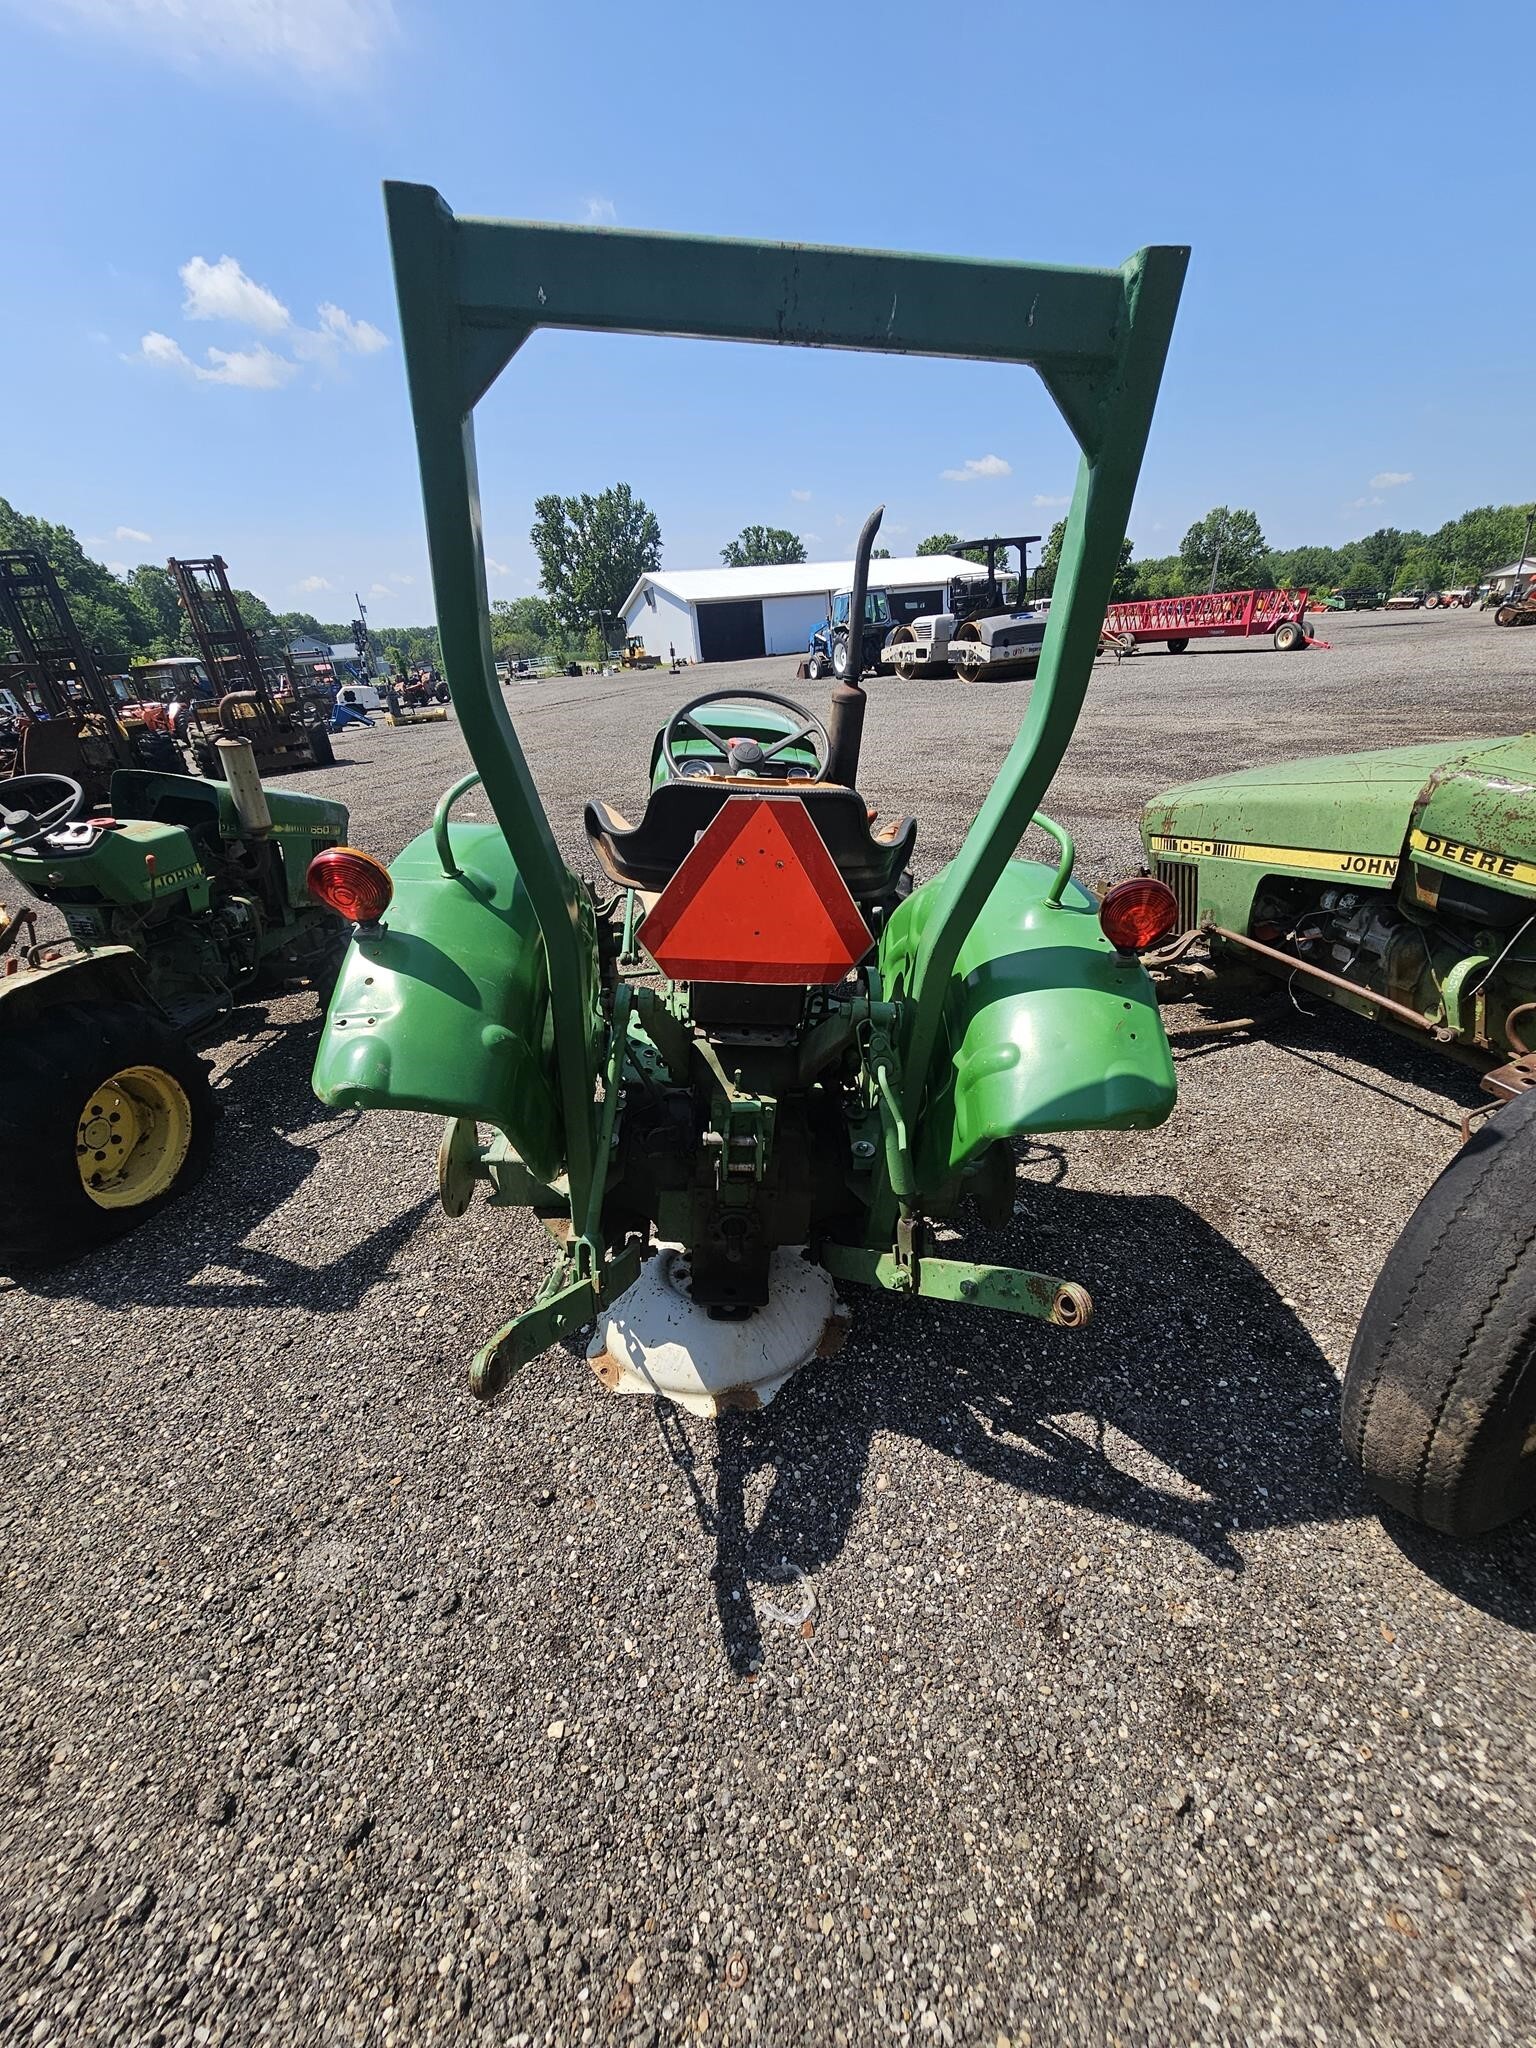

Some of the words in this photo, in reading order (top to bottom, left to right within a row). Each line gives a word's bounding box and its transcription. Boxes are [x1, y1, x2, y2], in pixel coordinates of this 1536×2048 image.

[310, 825, 330, 835] 650
[1176, 838, 1214, 856] 1050
[1340, 856, 1397, 876] JOHN
[1424, 836, 1519, 878] DEERE
[156, 866, 195, 888] JOHN
